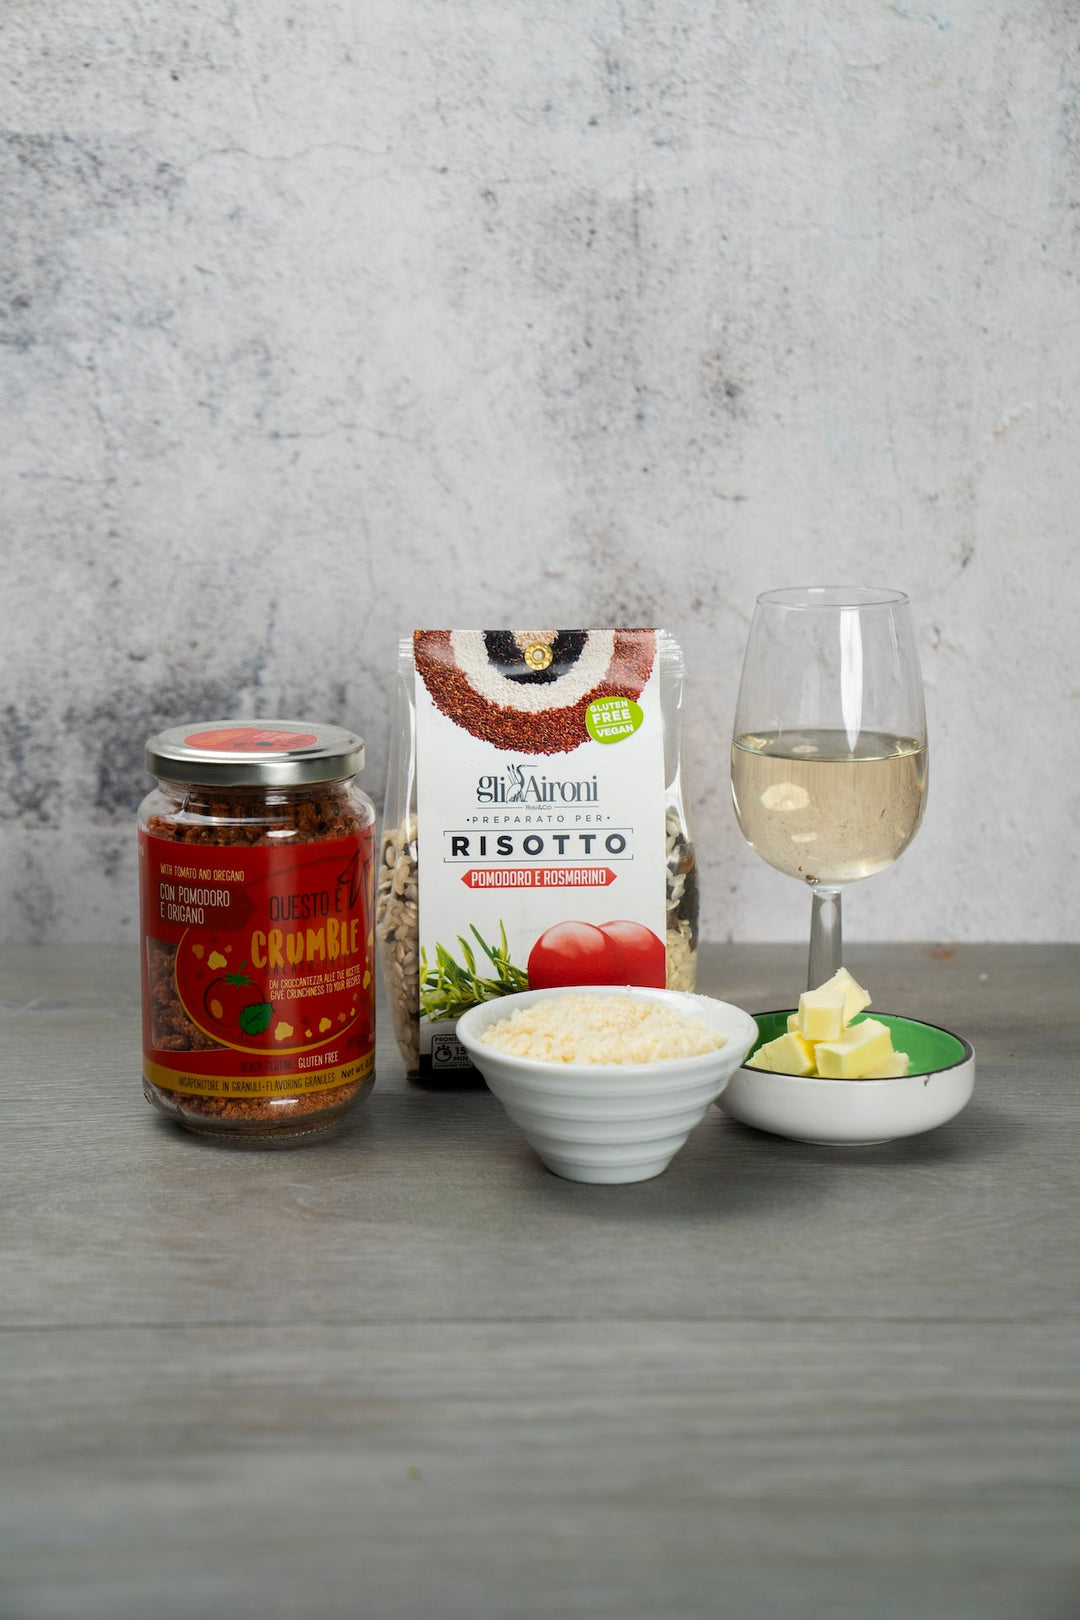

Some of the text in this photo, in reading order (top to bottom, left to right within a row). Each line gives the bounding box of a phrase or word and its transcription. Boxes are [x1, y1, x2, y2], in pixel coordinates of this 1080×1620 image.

[590, 700, 628, 712] GLUTEN
[592, 708, 631, 724] FREE
[596, 724, 634, 737] VEGAN
[476, 775, 600, 803] gli Aironi
[472, 814, 603, 824] PREPARATO PER
[451, 833, 627, 857] RISOTTO
[160, 863, 245, 882] WITH TOMATO AND OREGANO
[471, 869, 607, 887] POMODORO E ROSMARINO
[160, 882, 230, 908] CON POMODORO
[160, 901, 205, 925] E ORIGANO
[269, 891, 330, 922] QUESTO
[250, 917, 359, 969] CRUMBLE
[268, 979, 279, 990] DAI
[281, 973, 323, 989] CROCCANTEZZA
[324, 971, 336, 983] ALLE
[270, 989, 285, 1000] GIVE
[287, 984, 325, 1000] CRUNCHINESS
[326, 982, 333, 994] TO
[334, 979, 346, 992] YOUR
[298, 1055, 323, 1069] GLUTEN
[325, 1051, 340, 1064] FREE
[456, 1046, 467, 1055] 15
[179, 1072, 336, 1093] INSAPORITORE IN GRANULI FLAVORING GRANULES
[341, 1068, 354, 1079] Net
